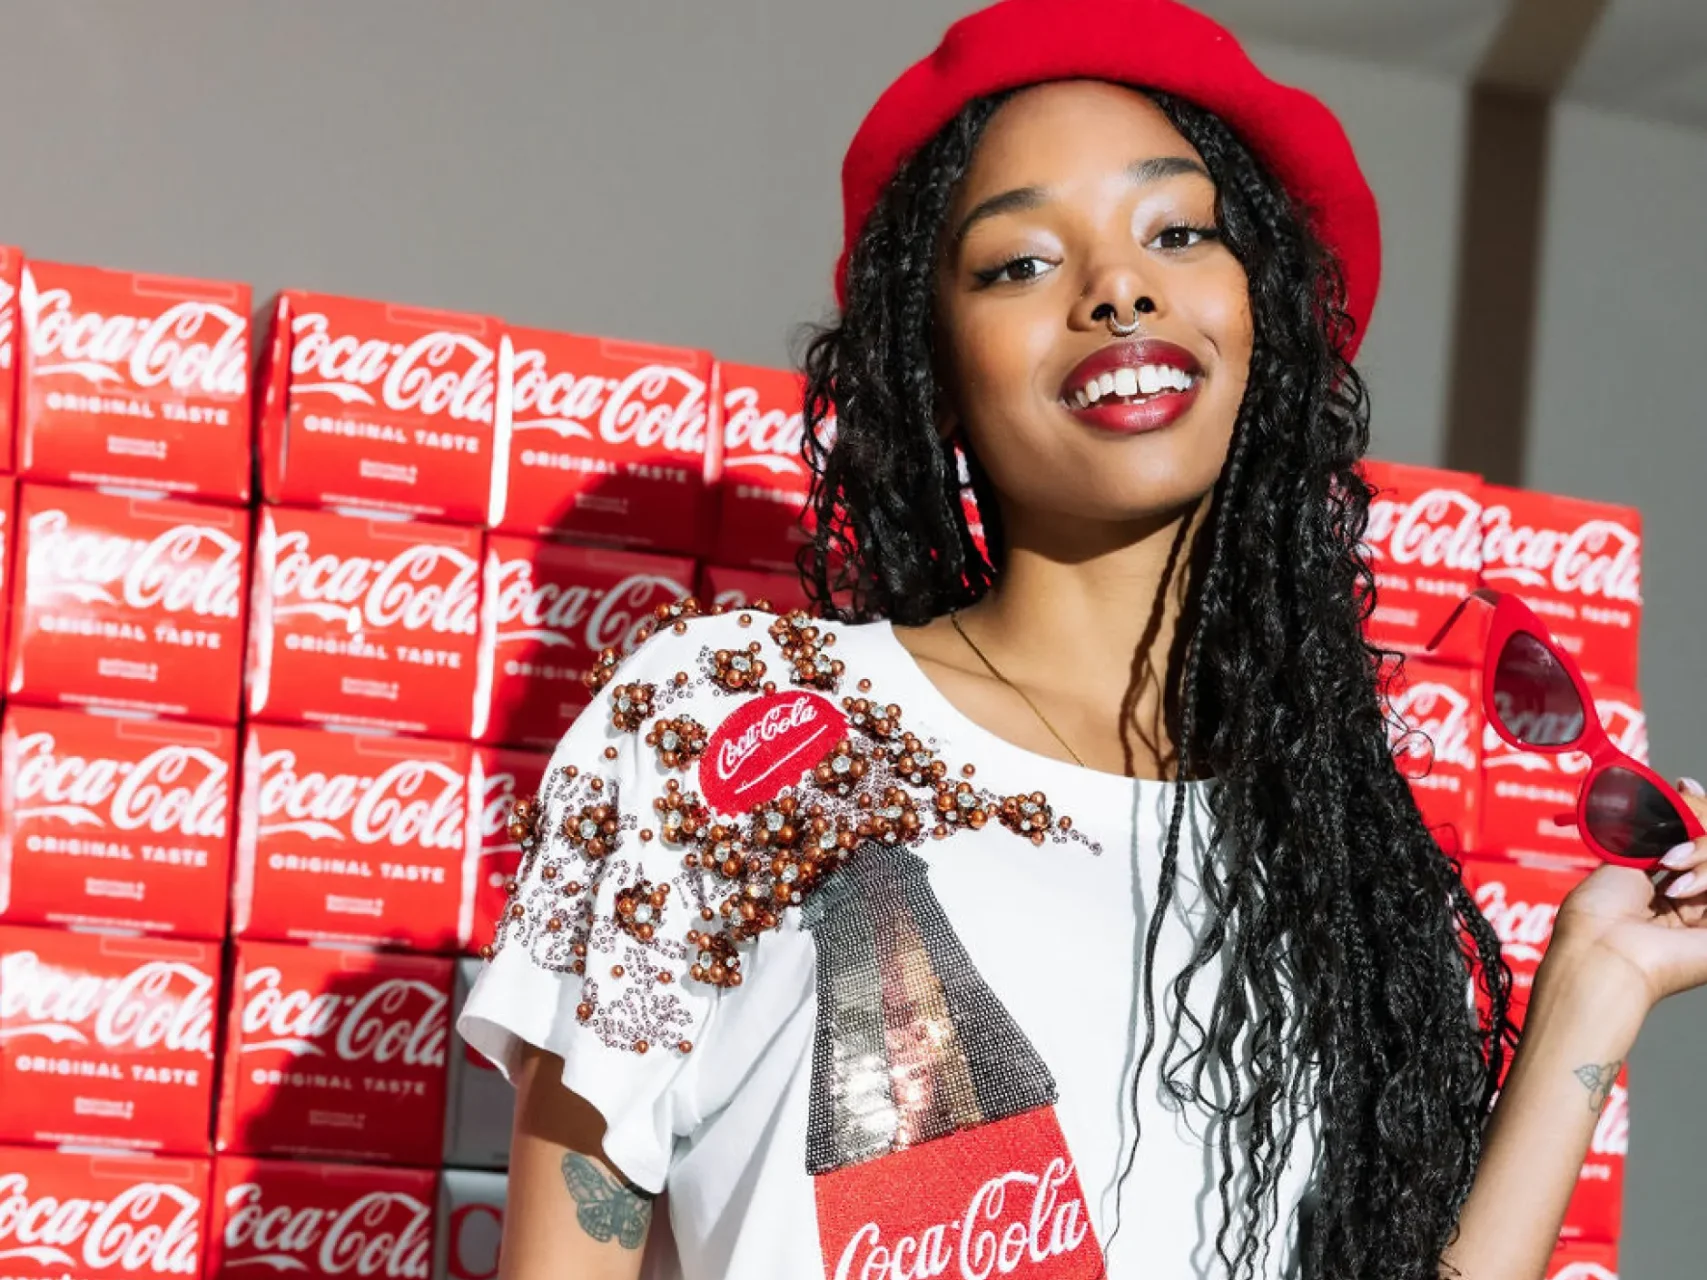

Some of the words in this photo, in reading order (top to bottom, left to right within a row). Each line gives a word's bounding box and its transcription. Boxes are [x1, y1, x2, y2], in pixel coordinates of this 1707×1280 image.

[47, 391, 154, 421] ORIGINAL
[161, 397, 229, 427] TASTE
[303, 415, 407, 443] ORIGINAL
[415, 430, 478, 453] TASTE
[520, 449, 618, 476] ORIGINAL
[627, 462, 687, 484] TASTE
[1368, 489, 1481, 571] a-Cola
[154, 621, 220, 649] TASTE
[396, 643, 462, 669] TASTE
[504, 660, 583, 681] ORIGIN
[717, 694, 817, 780] Coca-Cola
[26, 835, 133, 860] ORIGINAL
[141, 843, 207, 868] TASTE
[269, 853, 371, 877] ORIGINAL
[381, 863, 444, 883] TASTE
[15, 1054, 123, 1082] ORIGINAL
[131, 1061, 199, 1087] TASTE
